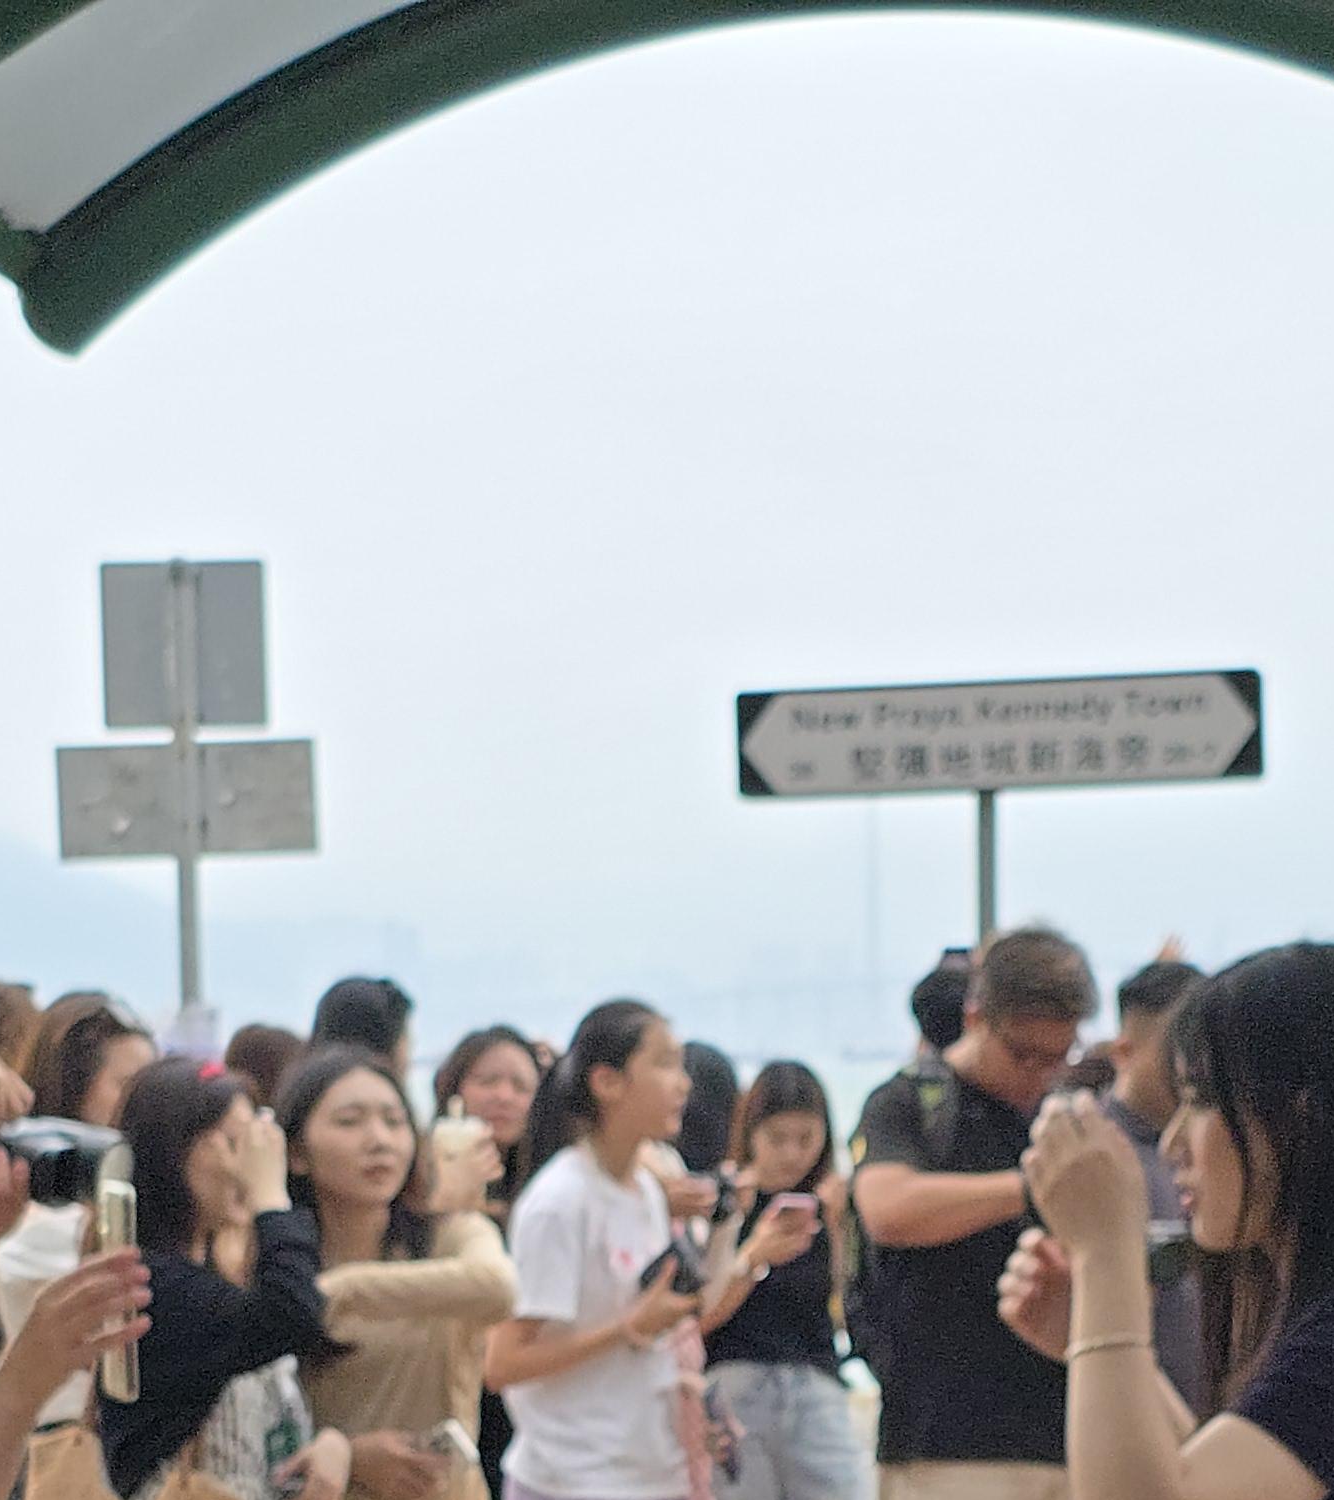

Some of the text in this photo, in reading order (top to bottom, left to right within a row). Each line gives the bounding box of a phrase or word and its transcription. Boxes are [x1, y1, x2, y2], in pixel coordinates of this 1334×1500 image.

[790, 689, 1209, 733] New Praya Kennedy Town
